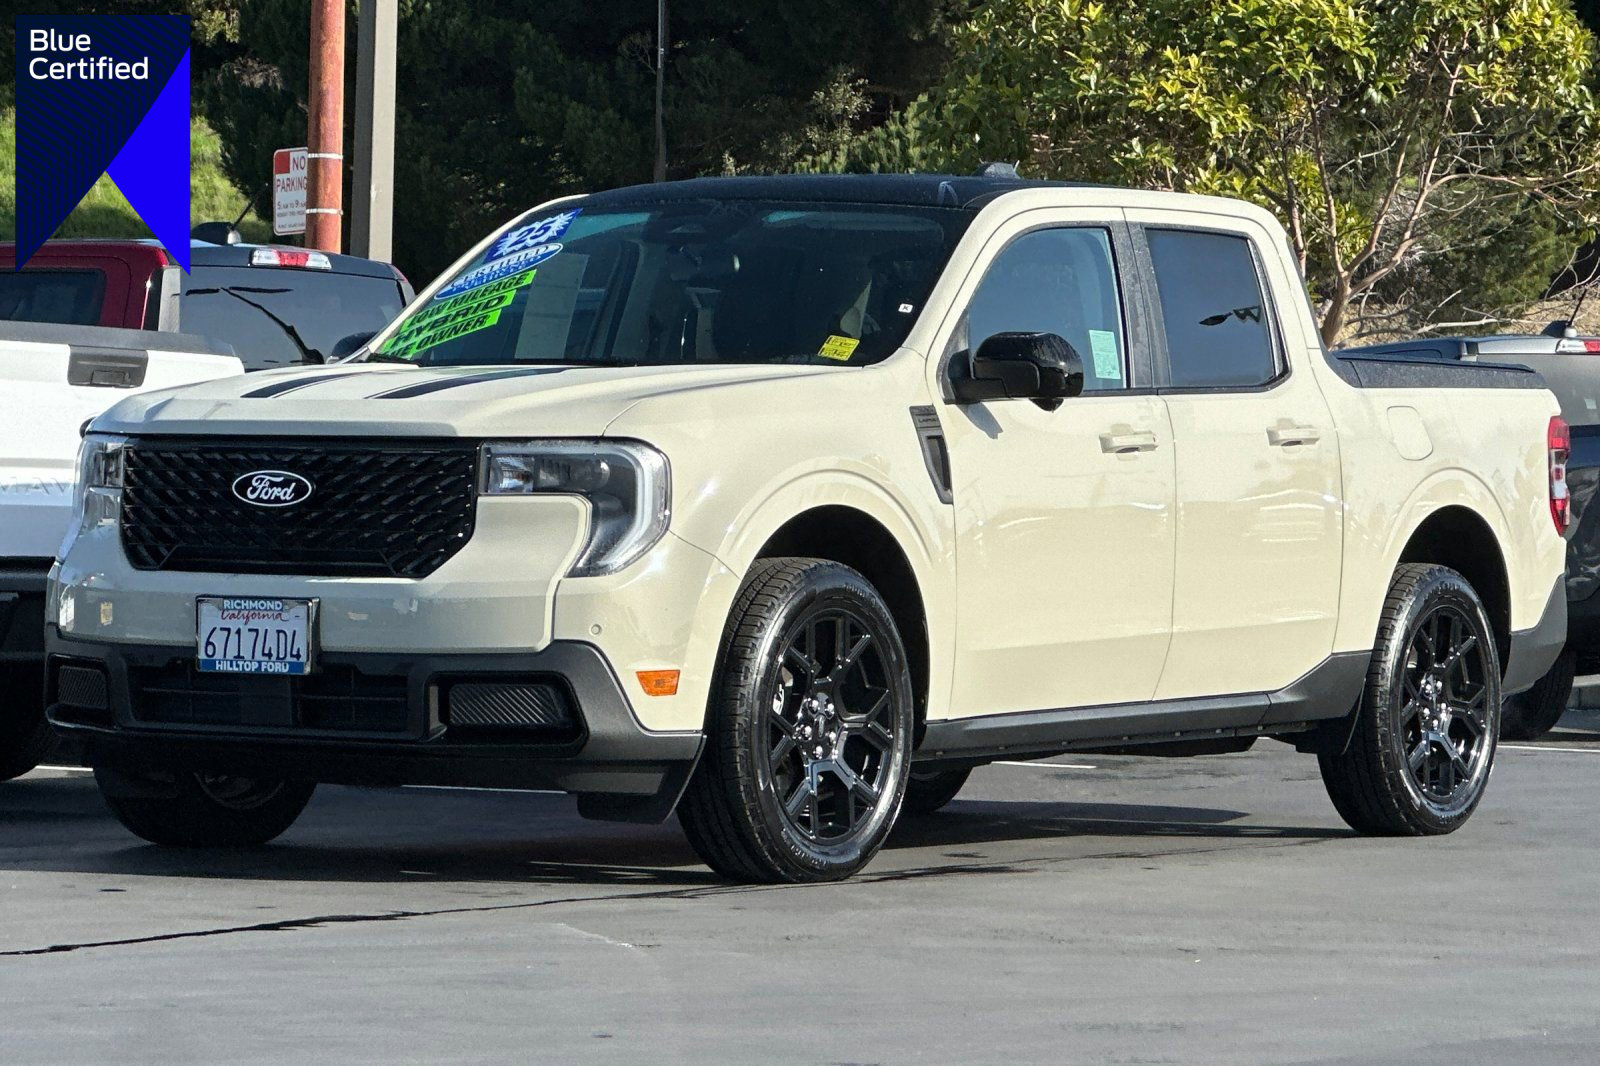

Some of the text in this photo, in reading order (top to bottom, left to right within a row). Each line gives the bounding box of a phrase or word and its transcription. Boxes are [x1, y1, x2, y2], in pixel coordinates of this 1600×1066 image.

[292, 156, 306, 171] NO
[508, 220, 556, 248] 25
[407, 301, 450, 328] LOW
[447, 273, 530, 311] MILEAGE
[390, 294, 508, 349] HYBRID
[415, 313, 491, 350] OWNER
[247, 475, 296, 500] Ford
[221, 610, 289, 625] California
[223, 600, 283, 611] RICHMOND
[204, 626, 302, 661] 67174D4
[215, 660, 290, 673] HILLTOP FORD
